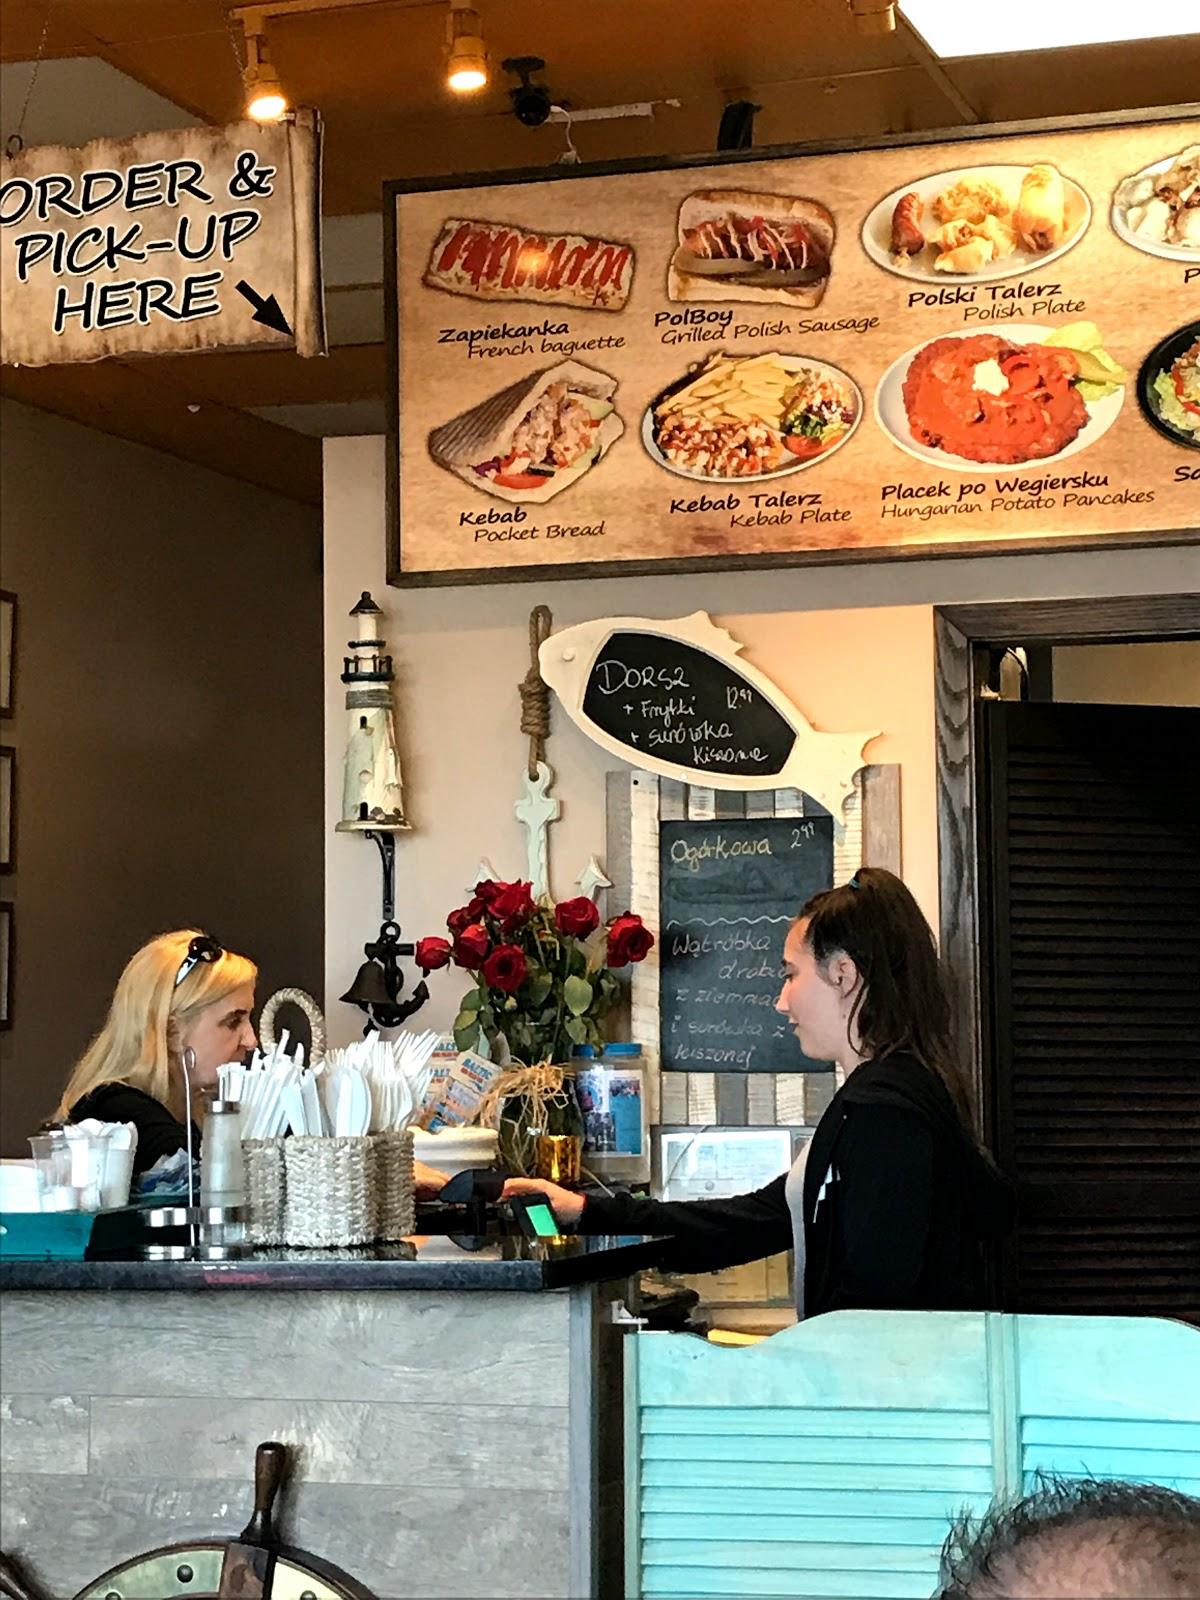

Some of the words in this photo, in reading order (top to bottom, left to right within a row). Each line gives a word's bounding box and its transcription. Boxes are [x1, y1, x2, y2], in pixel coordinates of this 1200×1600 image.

[0, 159, 213, 226] ORDER
[228, 150, 277, 198] &
[14, 209, 261, 283] PICK-UP
[53, 270, 225, 334] HERE
[908, 285, 977, 307] Polski
[984, 282, 1063, 300] Talerz
[654, 308, 734, 332] PolBoy
[963, 302, 1024, 321] Polish
[1031, 298, 1087, 316] Plate
[437, 320, 570, 347] Zapiekanka
[661, 324, 726, 345] Grilled
[733, 320, 791, 339] Polish
[798, 315, 881, 333] Sausage
[468, 340, 534, 359] French
[540, 336, 626, 356] baguette
[880, 481, 952, 501] Placek
[958, 483, 986, 502] po
[995, 471, 1109, 497] Wegiersku
[670, 493, 741, 514] Kebab
[748, 491, 823, 509] Talerz
[880, 502, 983, 522] Hungarian
[990, 497, 1056, 513] Potato
[1063, 488, 1156, 508] Pancakes
[459, 506, 528, 527] Kebab
[730, 510, 793, 528] Kebab
[800, 508, 853, 525] Plate
[474, 526, 540, 543] Pocket
[546, 520, 606, 539] Bread
